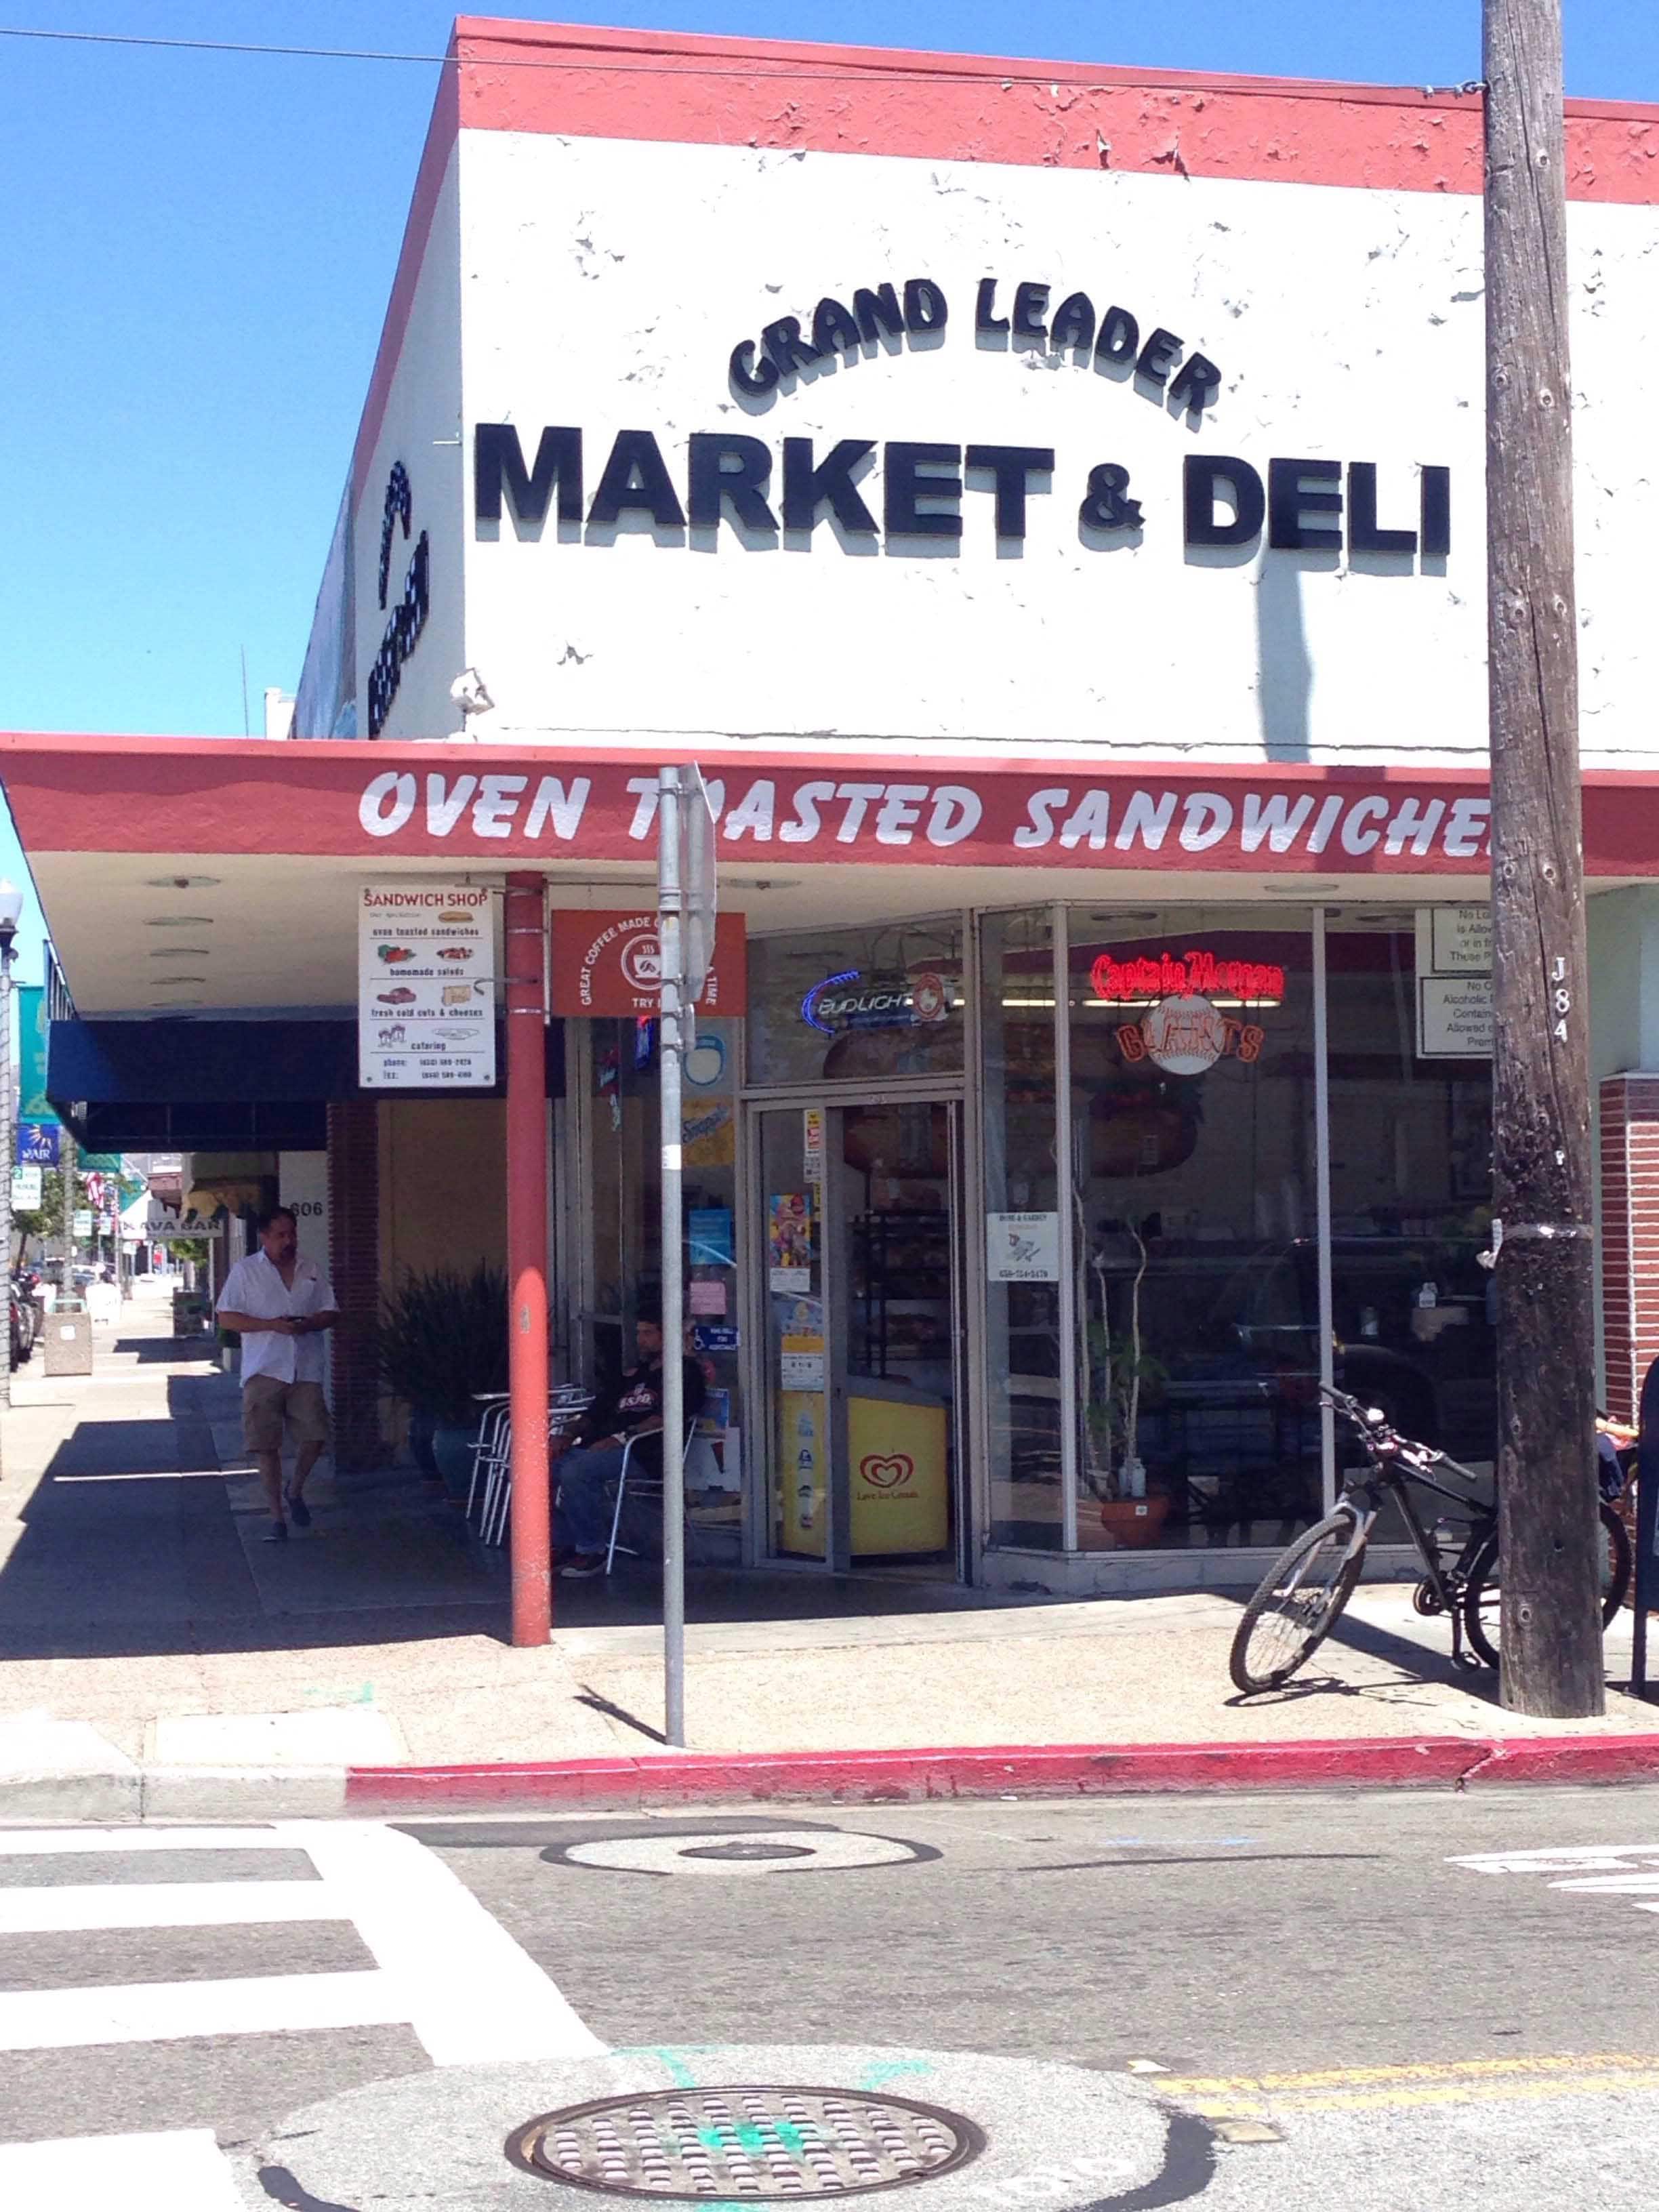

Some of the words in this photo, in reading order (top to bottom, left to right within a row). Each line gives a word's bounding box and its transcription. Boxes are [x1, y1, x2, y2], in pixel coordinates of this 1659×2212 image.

[729, 279, 947, 396] GRAND
[975, 277, 1221, 416] LEADER
[475, 424, 1054, 539] MARKET
[1079, 464, 1145, 530] &
[1184, 455, 1450, 555] DELI
[359, 771, 591, 839] OVEN
[1013, 788, 1491, 857] SANDWICHE
[364, 893, 444, 907] SANDWICH
[447, 893, 488, 907] SHOP
[396, 927, 428, 936] toasted
[431, 927, 479, 936] sandwiches
[617, 917, 651, 933] MADE
[585, 928, 618, 965] COFFEE
[390, 968, 434, 977] homemade
[437, 968, 464, 977] salads
[1090, 951, 1186, 1002] Captain
[1184, 951, 1285, 1001] Morgan
[579, 967, 592, 1006] GREAT
[706, 977, 718, 1005] TIME
[632, 997, 654, 1008] TRY
[371, 1008, 394, 1017] fresh
[396, 1008, 415, 1017] cold
[417, 1008, 436, 1017] cuts
[440, 1008, 445, 1017] &
[449, 1008, 483, 1017] cheeses
[411, 1042, 447, 1051] catering
[1114, 1017, 1266, 1063] GIANTS
[290, 1202, 323, 1216] 606
[180, 1221, 221, 1231] BAR
